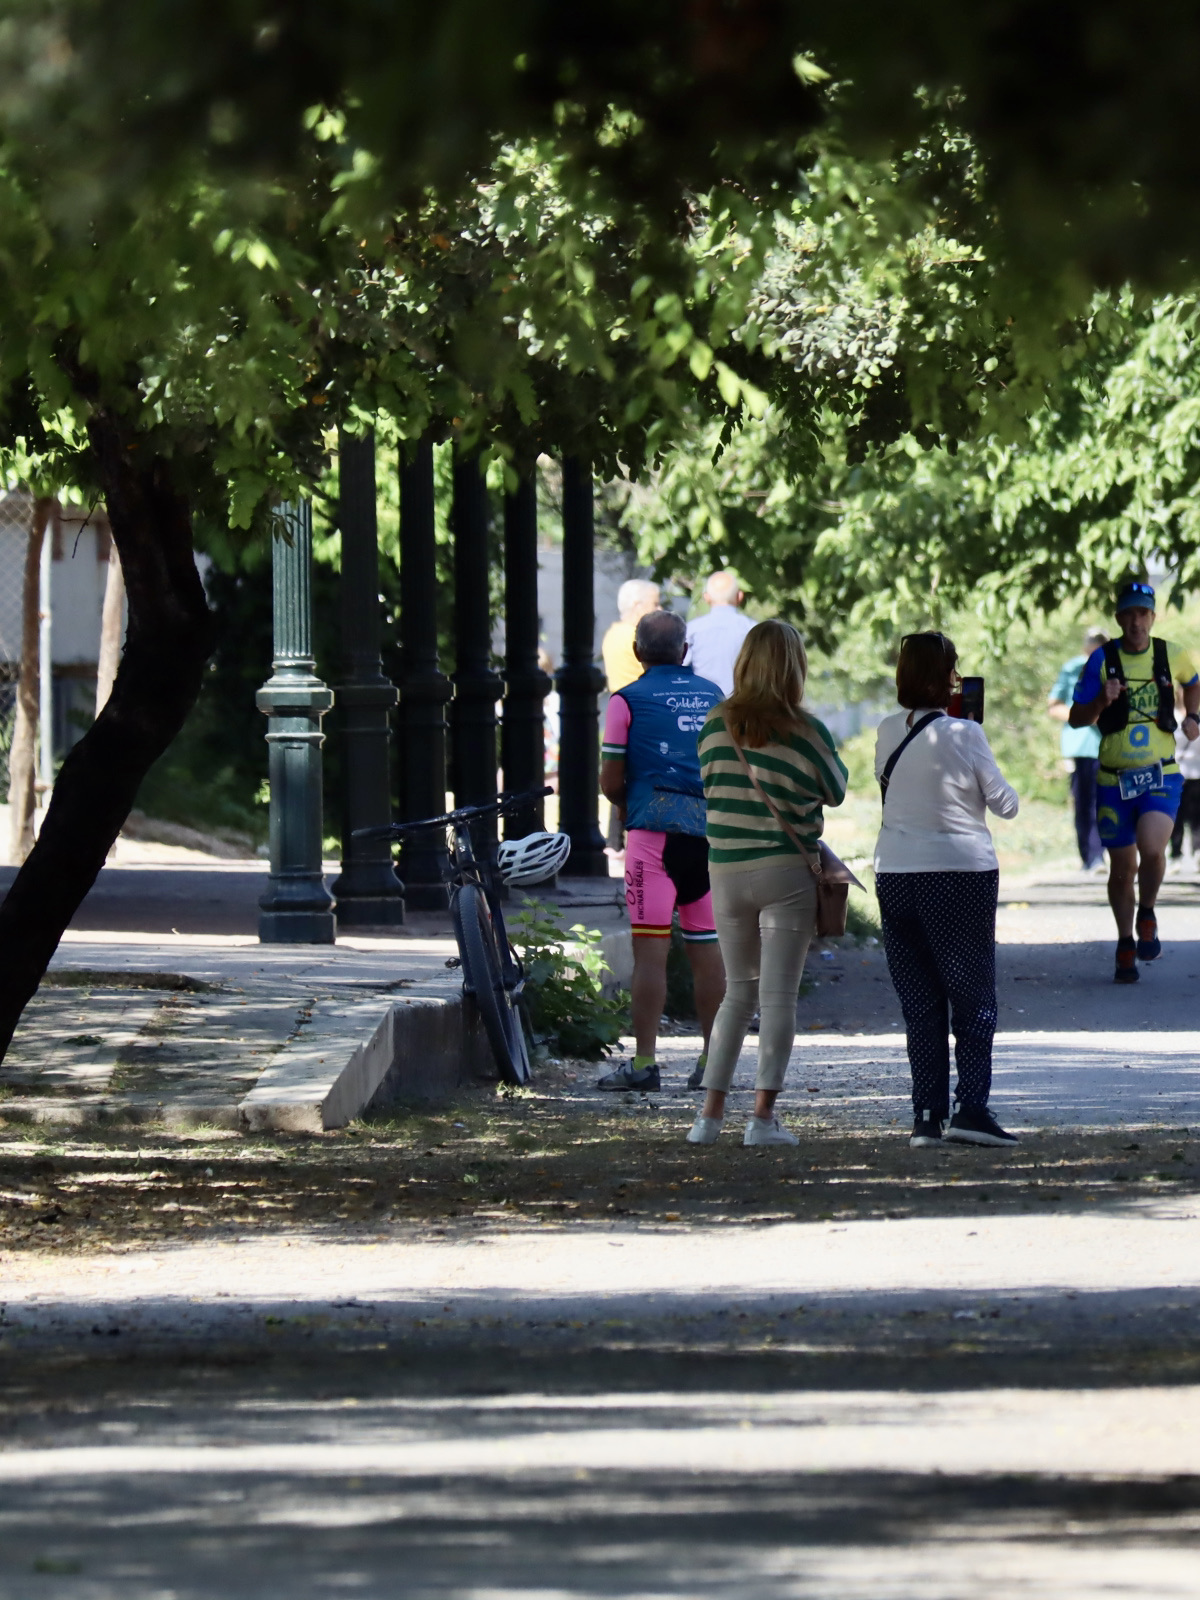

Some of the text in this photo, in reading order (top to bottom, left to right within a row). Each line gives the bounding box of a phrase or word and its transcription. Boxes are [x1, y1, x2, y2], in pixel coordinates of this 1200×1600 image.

[1133, 772, 1154, 785] 123
[636, 861, 645, 920] ENCINAS REALES
